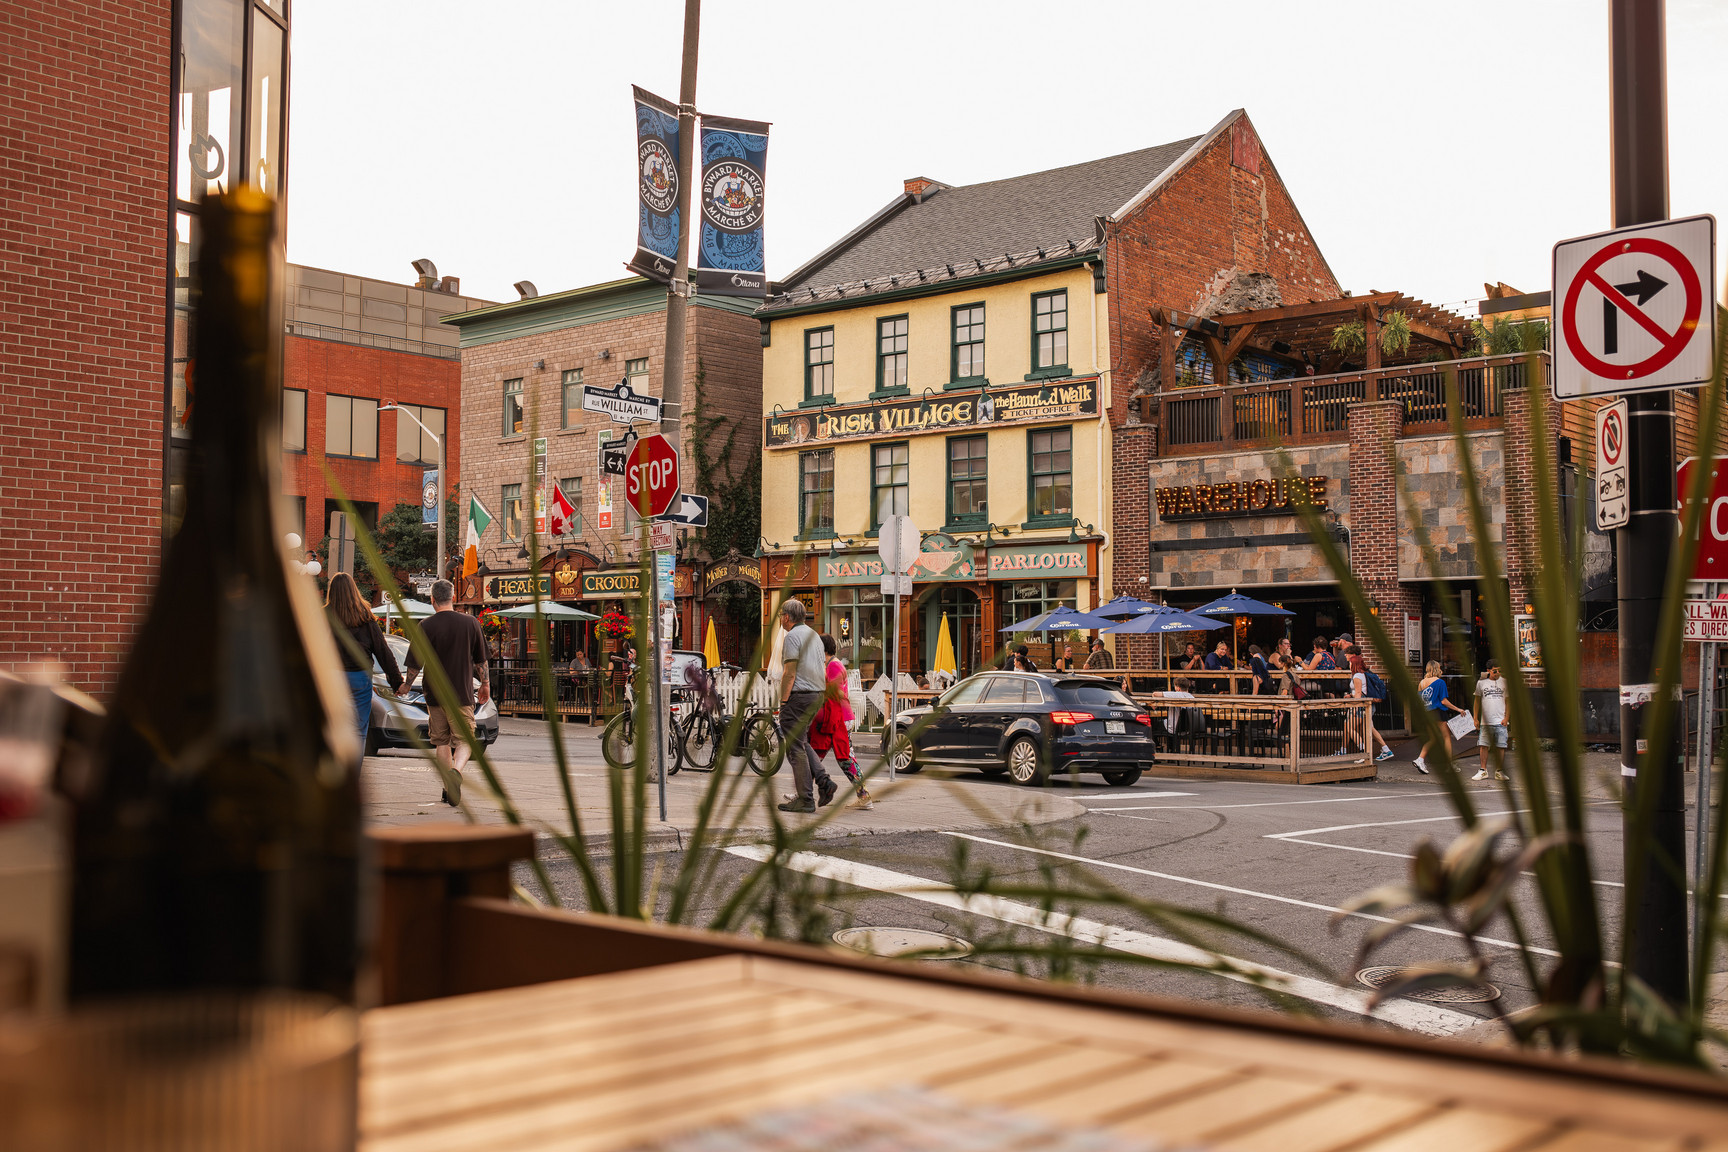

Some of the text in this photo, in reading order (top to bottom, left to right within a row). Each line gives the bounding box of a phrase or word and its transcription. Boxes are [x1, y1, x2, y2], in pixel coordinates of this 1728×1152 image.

[657, 146, 675, 183] MARKET
[703, 165, 764, 199] BYWARD MARKET
[640, 183, 672, 209] MARCHÉ BY
[707, 205, 757, 227] MARCHÉ BY
[731, 273, 760, 288] Ottawa
[1059, 384, 1092, 404] Walk
[591, 399, 600, 407] RUE
[600, 398, 643, 416] WILLIAM
[1010, 405, 1072, 417] TICKET OFFICE
[771, 423, 789, 436] THE
[879, 401, 972, 431] VILLAGE
[629, 458, 673, 495] STOP
[1155, 475, 1329, 515] WAREHOUSE
[650, 535, 672, 547] DIRECTIONS
[825, 560, 884, 577] NAN'S
[989, 553, 1087, 571] PARLOUR
[498, 577, 548, 595] HEART
[560, 587, 575, 596] AND
[584, 575, 640, 591] CROWN
[802, 598, 814, 608] 73
